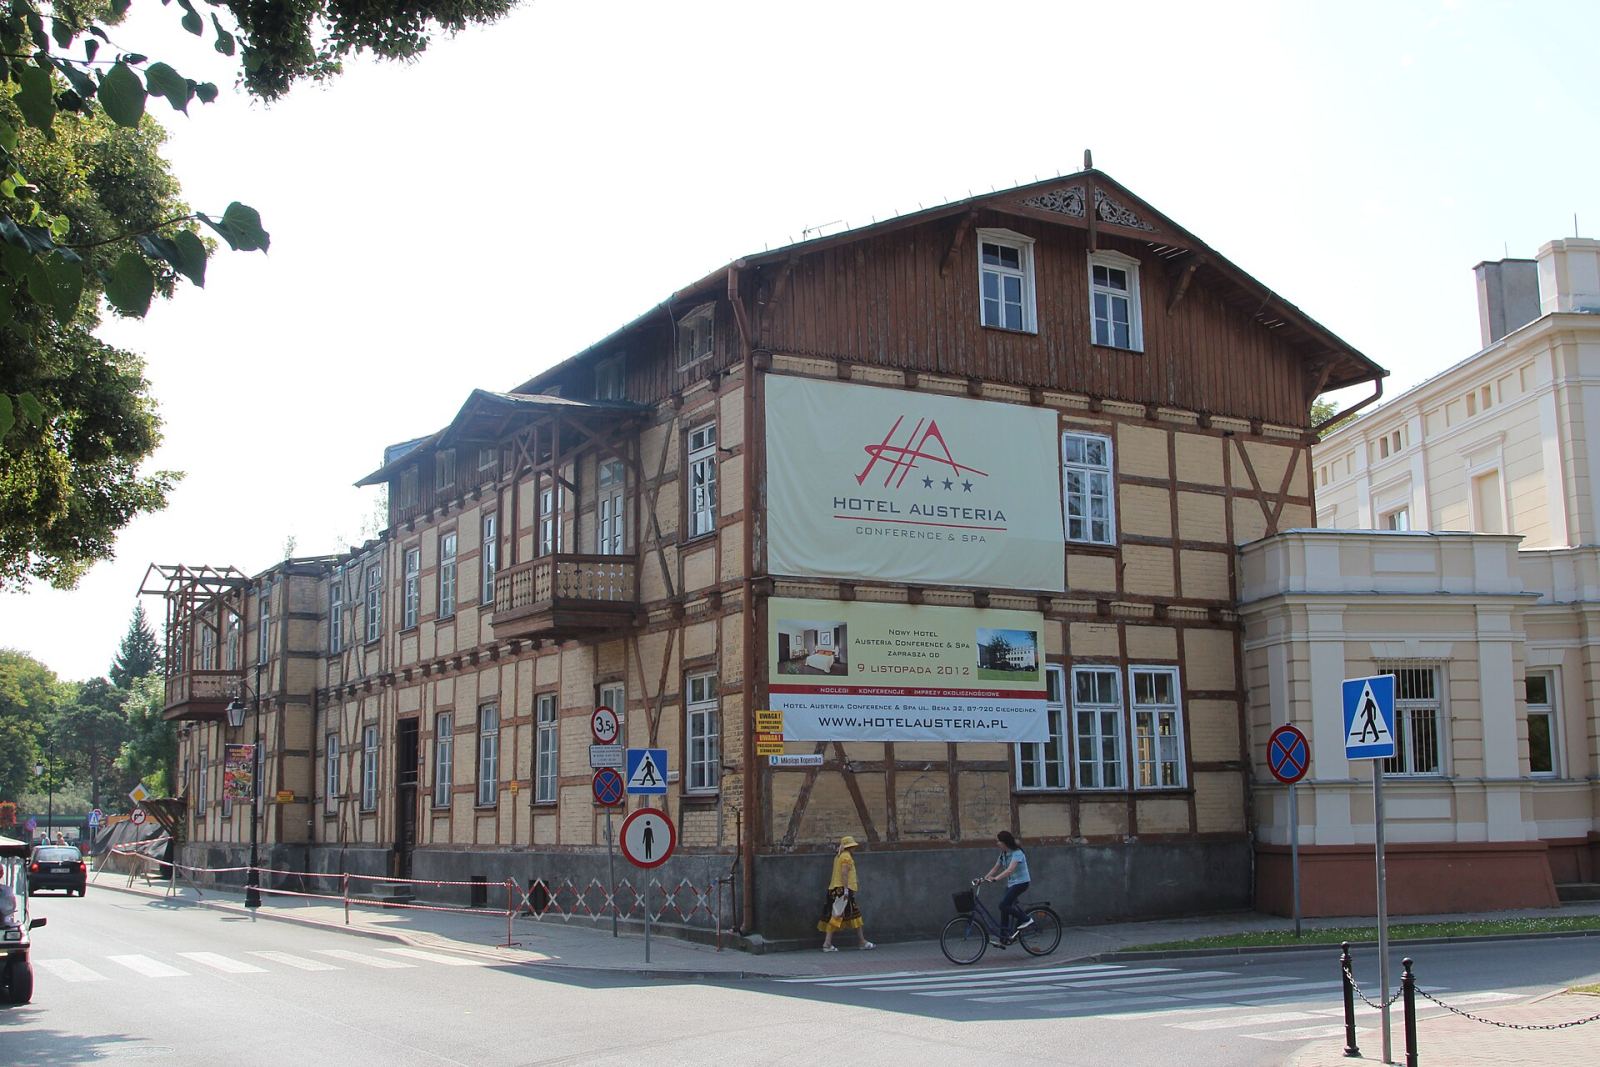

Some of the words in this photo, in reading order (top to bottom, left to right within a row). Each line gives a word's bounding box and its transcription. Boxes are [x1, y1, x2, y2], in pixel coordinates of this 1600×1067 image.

[833, 497, 901, 513] HOTEL
[909, 503, 1007, 522] AUSTERIA
[855, 526, 942, 541] CONFERENCE
[947, 533, 956, 541] &
[961, 534, 987, 543] SPA
[855, 638, 892, 646] AUSTERIA
[895, 639, 944, 648] CONFERENCE
[887, 650, 926, 658] ZAPRASZA
[857, 663, 865, 672] 9
[870, 665, 932, 674] LISTOPADA
[937, 666, 970, 675] 2012
[818, 717, 1008, 729] WWW.HOTELAUSTERIA.PL
